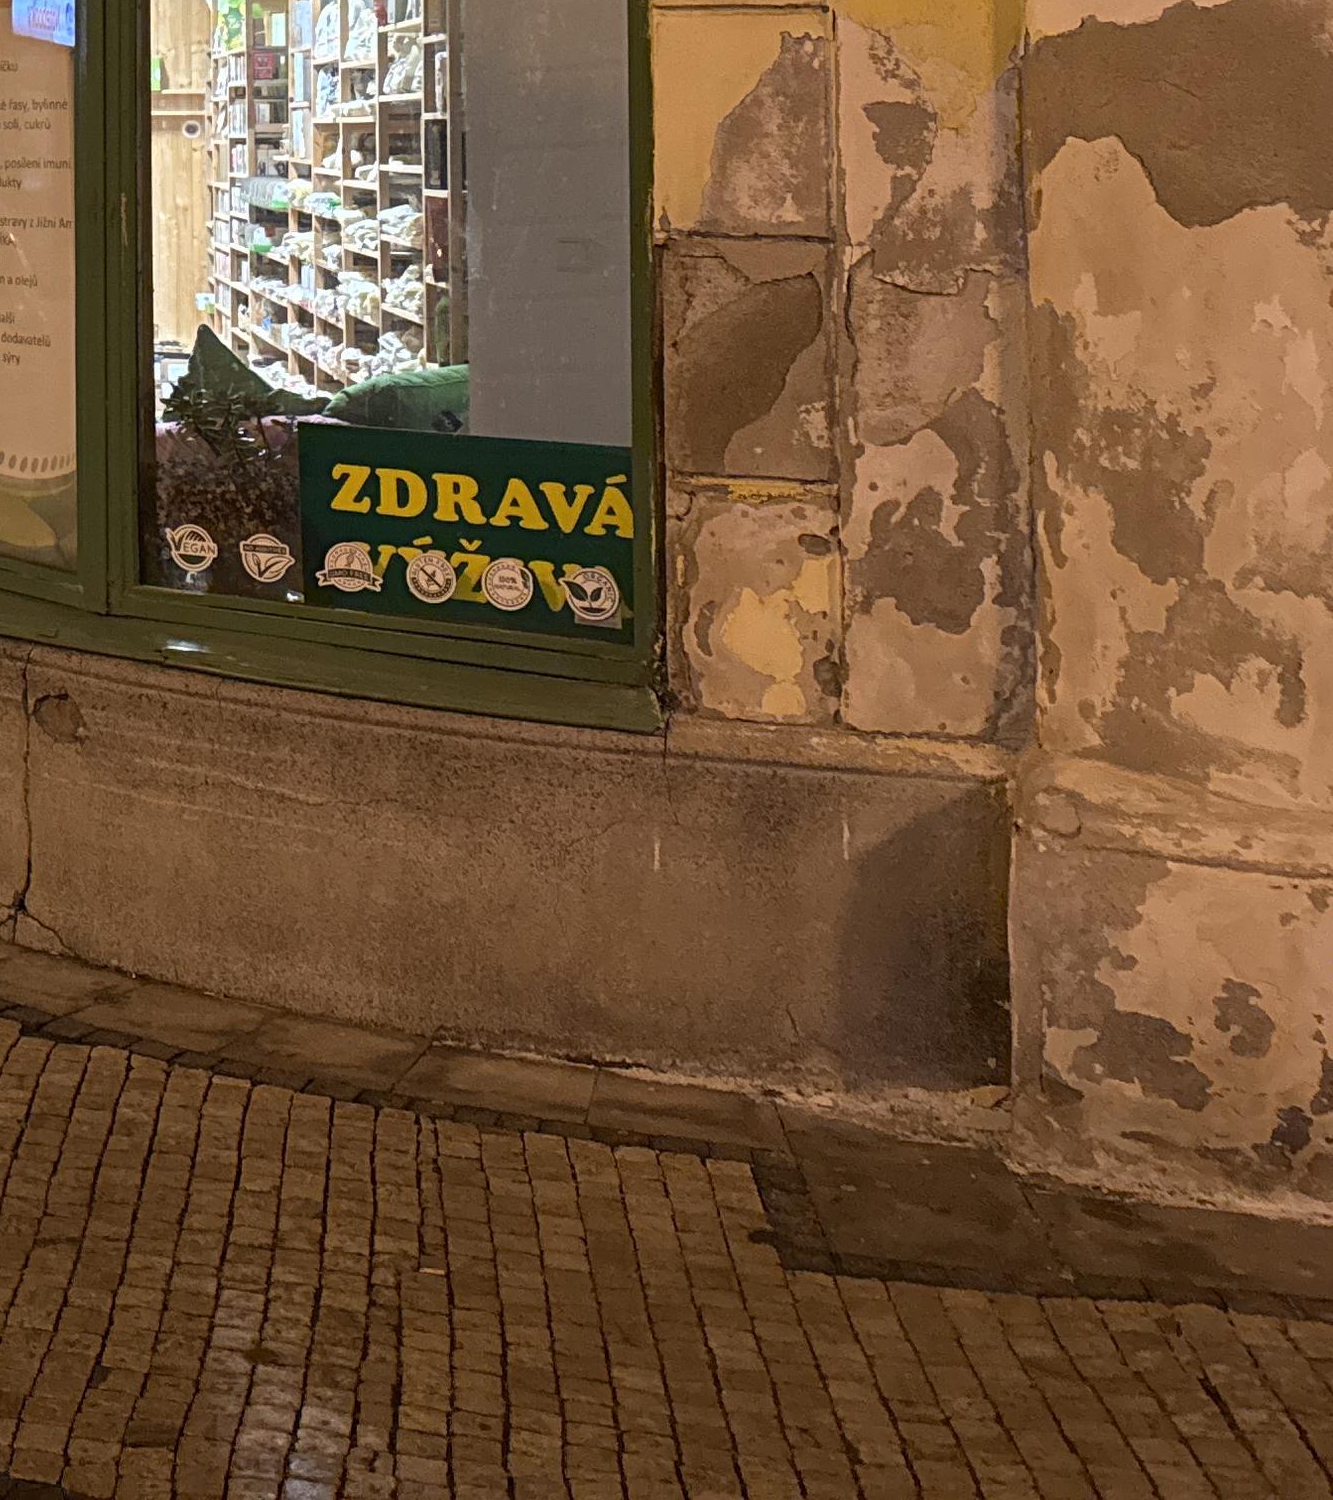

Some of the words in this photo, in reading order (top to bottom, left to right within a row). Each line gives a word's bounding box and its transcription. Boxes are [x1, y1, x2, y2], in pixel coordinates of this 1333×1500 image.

[24, 117, 52, 131] cukrů
[4, 156, 41, 171] posílení
[0, 215, 27, 230] stravy
[29, 218, 35, 228] z
[37, 215, 56, 229] Jižní
[7, 275, 13, 285] a
[15, 273, 38, 288] olejů
[0, 331, 52, 348] dodavatelů
[3, 350, 21, 366] sýry
[331, 463, 634, 539] ZDRAVÁ
[165, 528, 217, 556] VEGAN
[582, 570, 617, 605] ORGANIC
